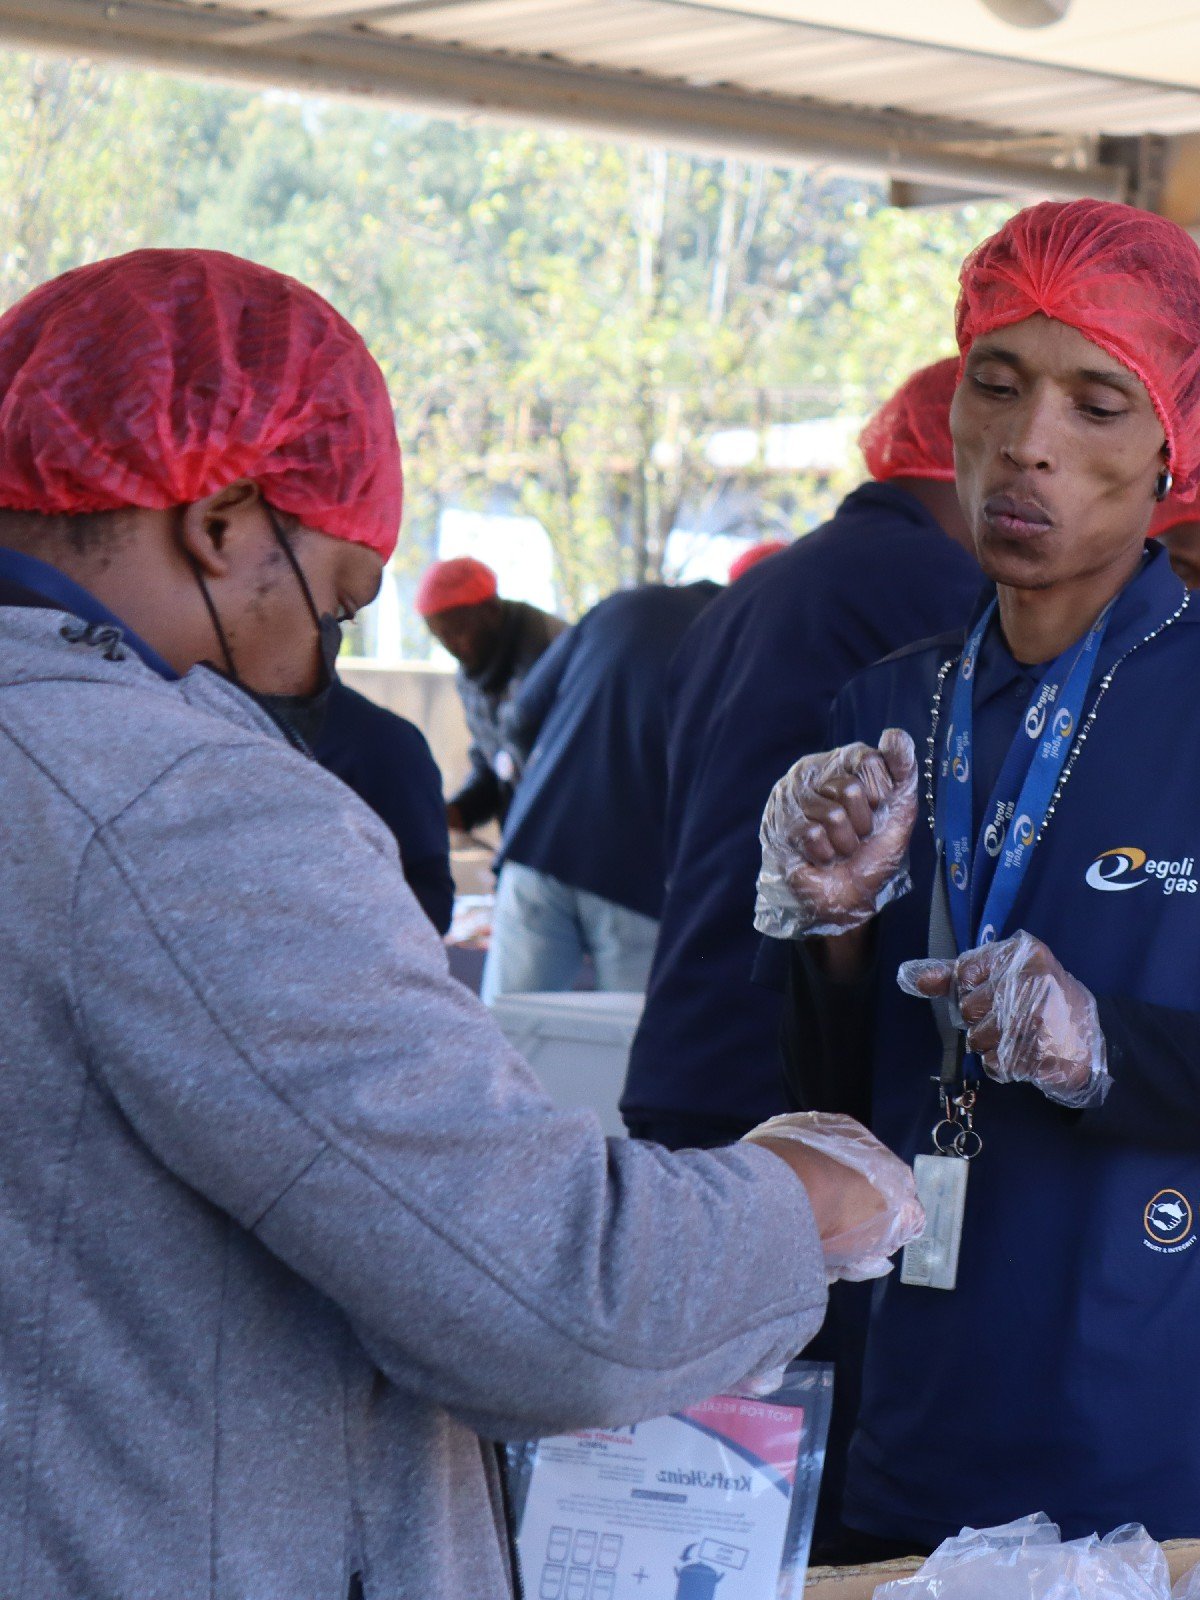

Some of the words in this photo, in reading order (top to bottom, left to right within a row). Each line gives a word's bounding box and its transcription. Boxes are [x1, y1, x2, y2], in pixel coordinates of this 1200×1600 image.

[1037, 684, 1051, 709] egoli
[1048, 684, 1058, 702] gas
[1042, 742, 1052, 758] gas
[1050, 735, 1062, 758] egoli
[994, 800, 1006, 826] egoli
[1005, 801, 1015, 819] gas
[1005, 850, 1014, 868] gas
[1013, 844, 1025, 868] egoli
[1145, 857, 1194, 882] egoli
[1164, 876, 1198, 895] gas
